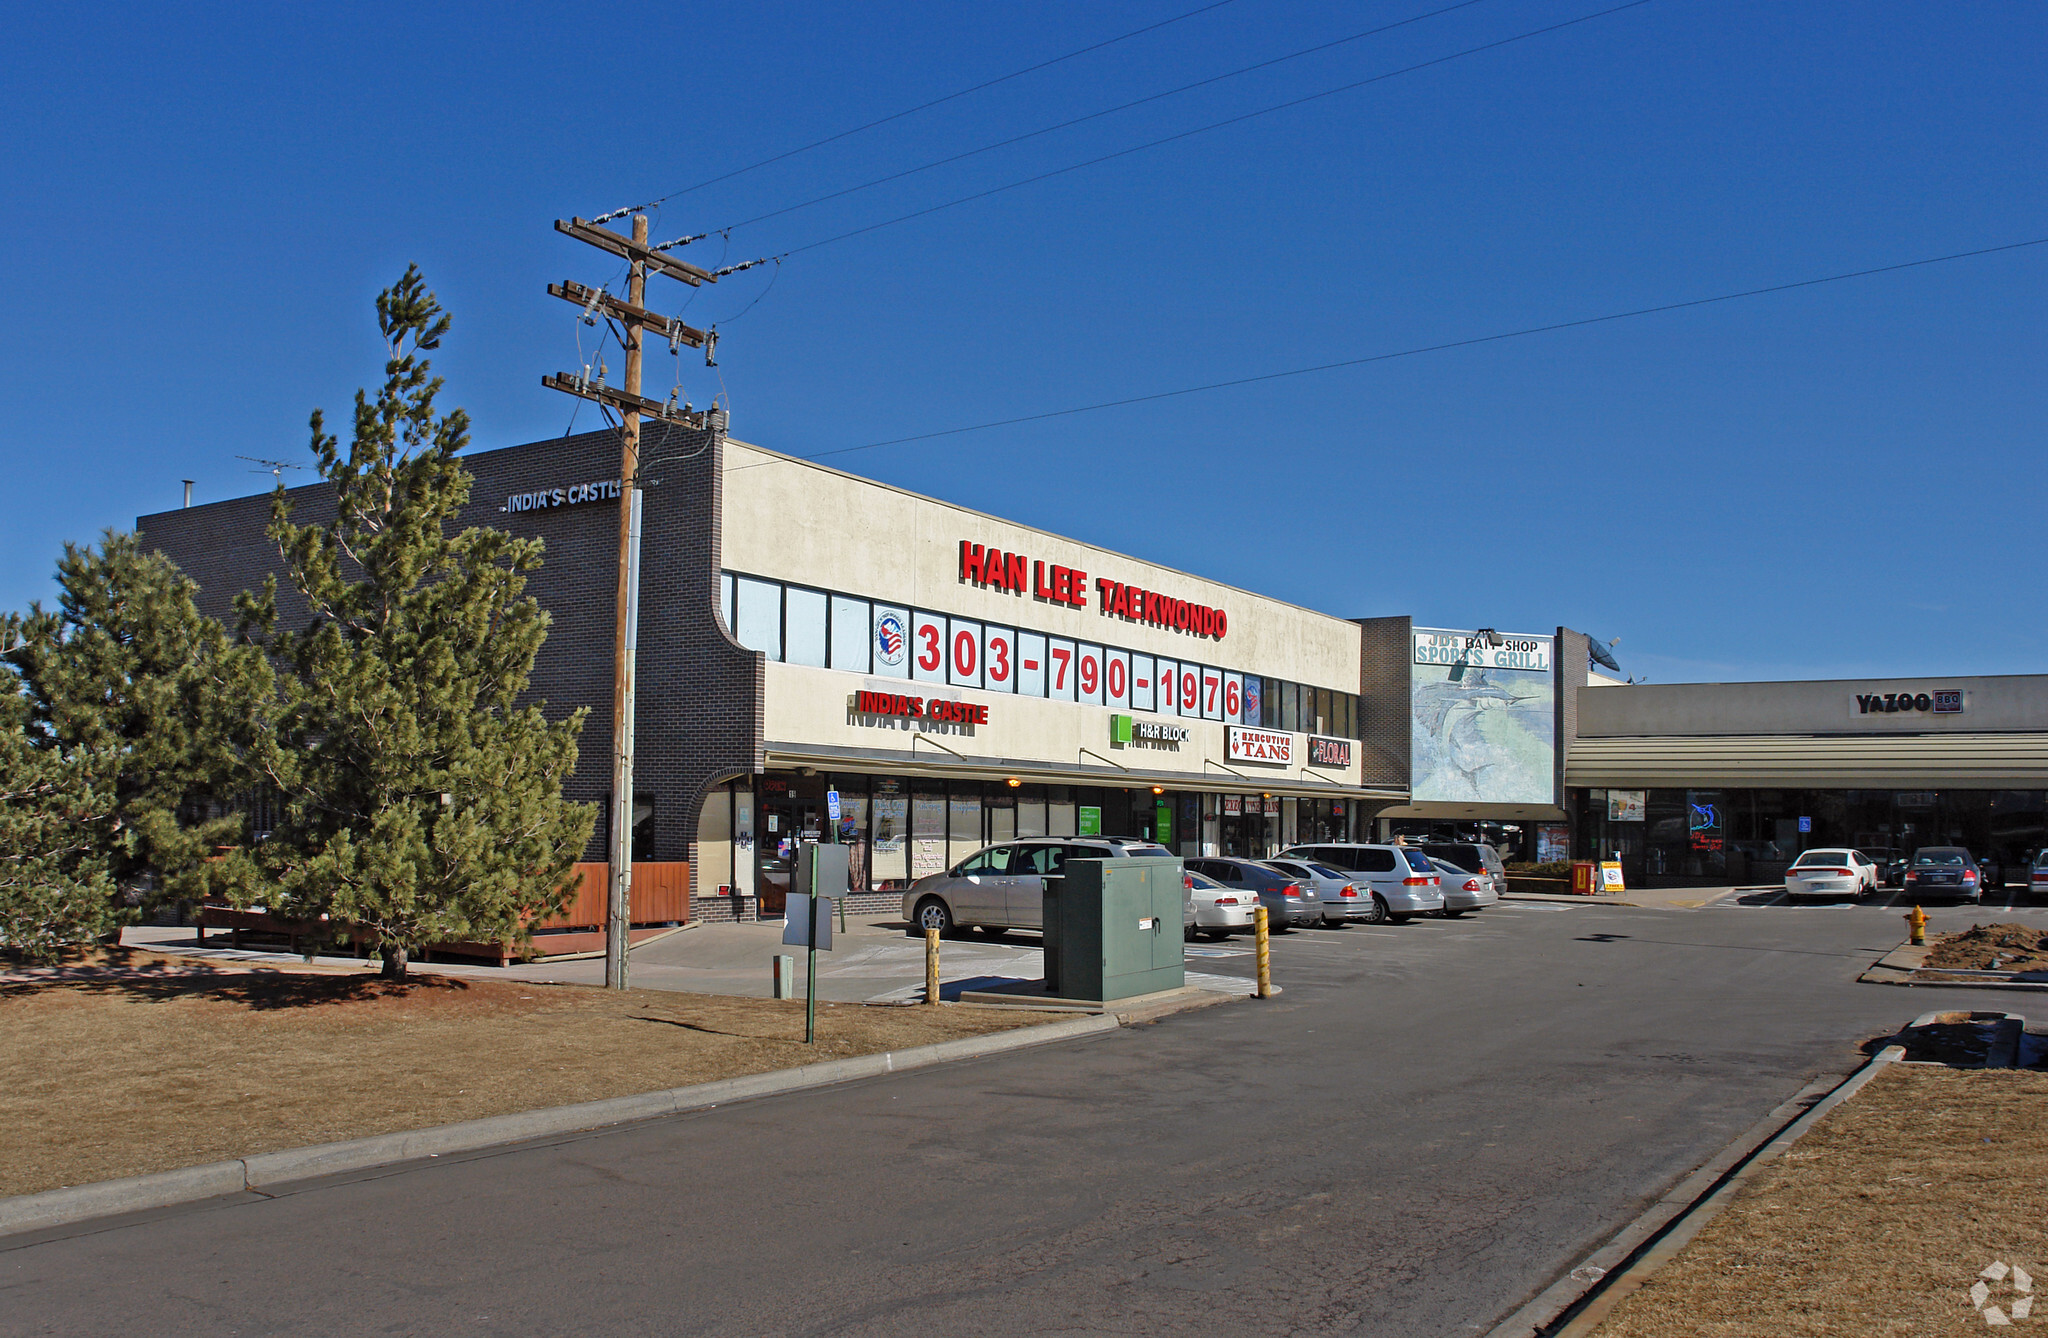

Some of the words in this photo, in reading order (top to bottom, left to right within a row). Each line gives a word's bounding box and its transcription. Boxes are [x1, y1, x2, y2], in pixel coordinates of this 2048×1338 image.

[507, 488, 561, 513] INDIA'S
[960, 540, 1027, 593] HAN
[1035, 560, 1088, 606] LEE
[1098, 577, 1228, 639] TAEKWONDO
[1417, 645, 1484, 666] SPORTS
[1494, 650, 1549, 669] GRILL
[1505, 640, 1538, 652] SHOP
[859, 690, 924, 718] INDIA'S
[930, 698, 989, 725] CASTLE
[1856, 693, 1931, 714] YAZOO
[1140, 723, 1160, 739] H&R
[1162, 726, 1192, 742] BLOCK
[1242, 732, 1290, 746] EXECUTIVE
[1242, 741, 1290, 761] TANS
[1318, 740, 1350, 765] FLORAL
